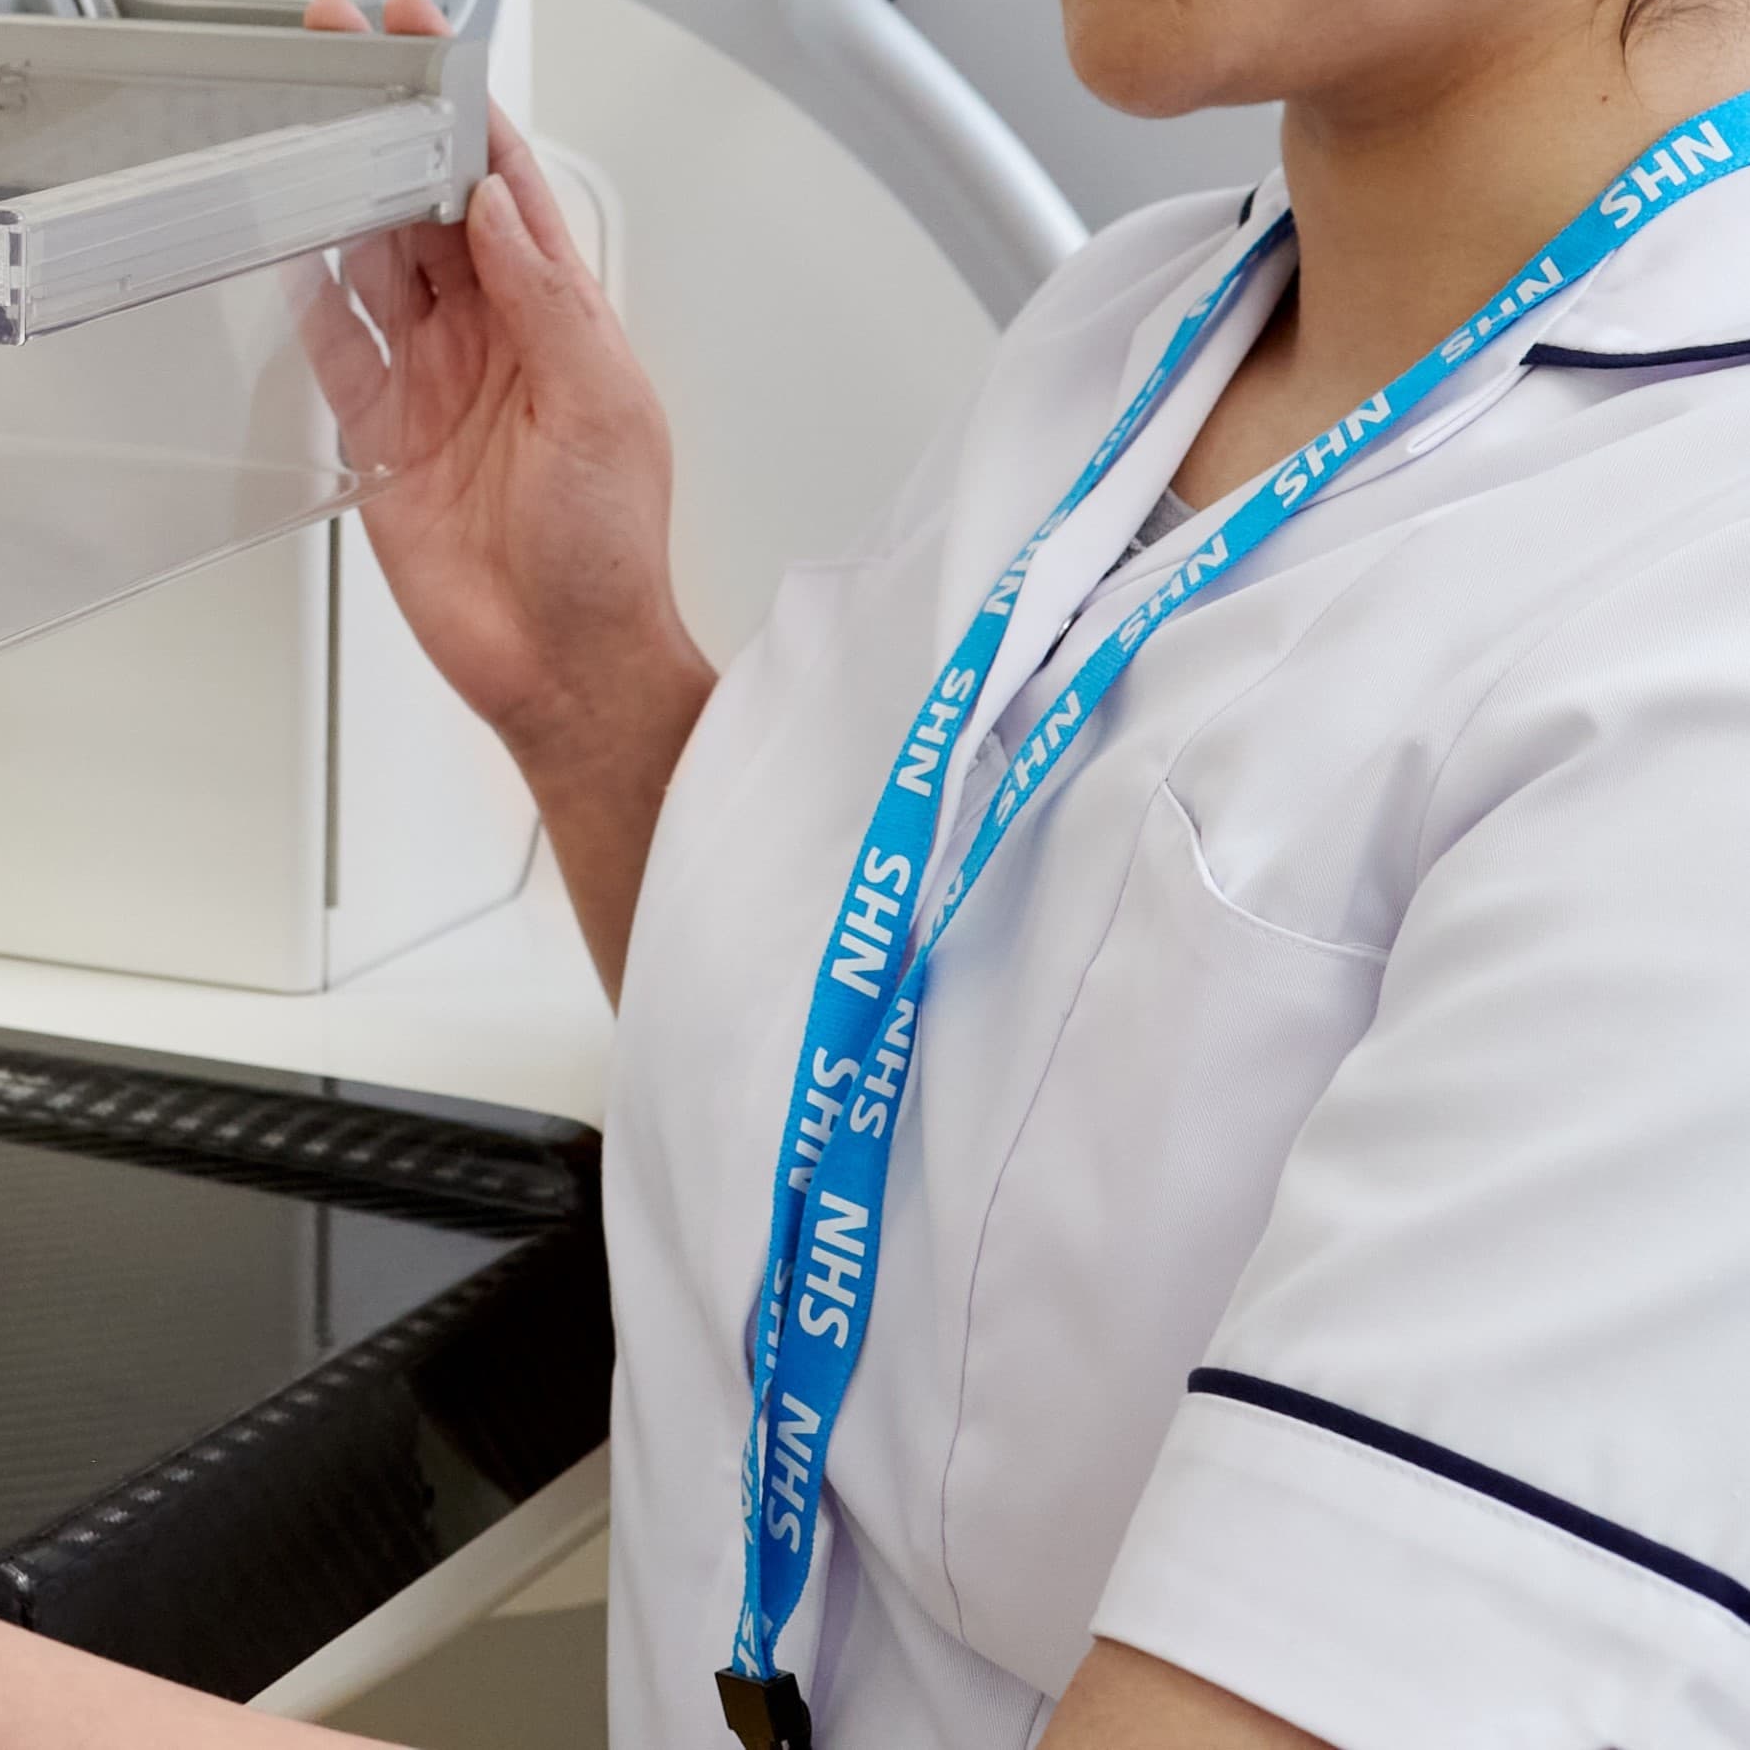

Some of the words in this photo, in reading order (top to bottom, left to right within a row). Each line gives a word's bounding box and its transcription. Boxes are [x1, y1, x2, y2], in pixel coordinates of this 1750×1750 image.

[1600, 120, 1734, 229] NHS
[1273, 391, 1392, 509] NHS
[1118, 533, 1230, 653] NHS
[896, 666, 976, 798] NHS
[995, 690, 1082, 827] NHS
[830, 847, 912, 1000] NHS
[849, 997, 916, 1139] NHS
[798, 1190, 870, 1349] NHS
[766, 1392, 822, 1555] NHS
